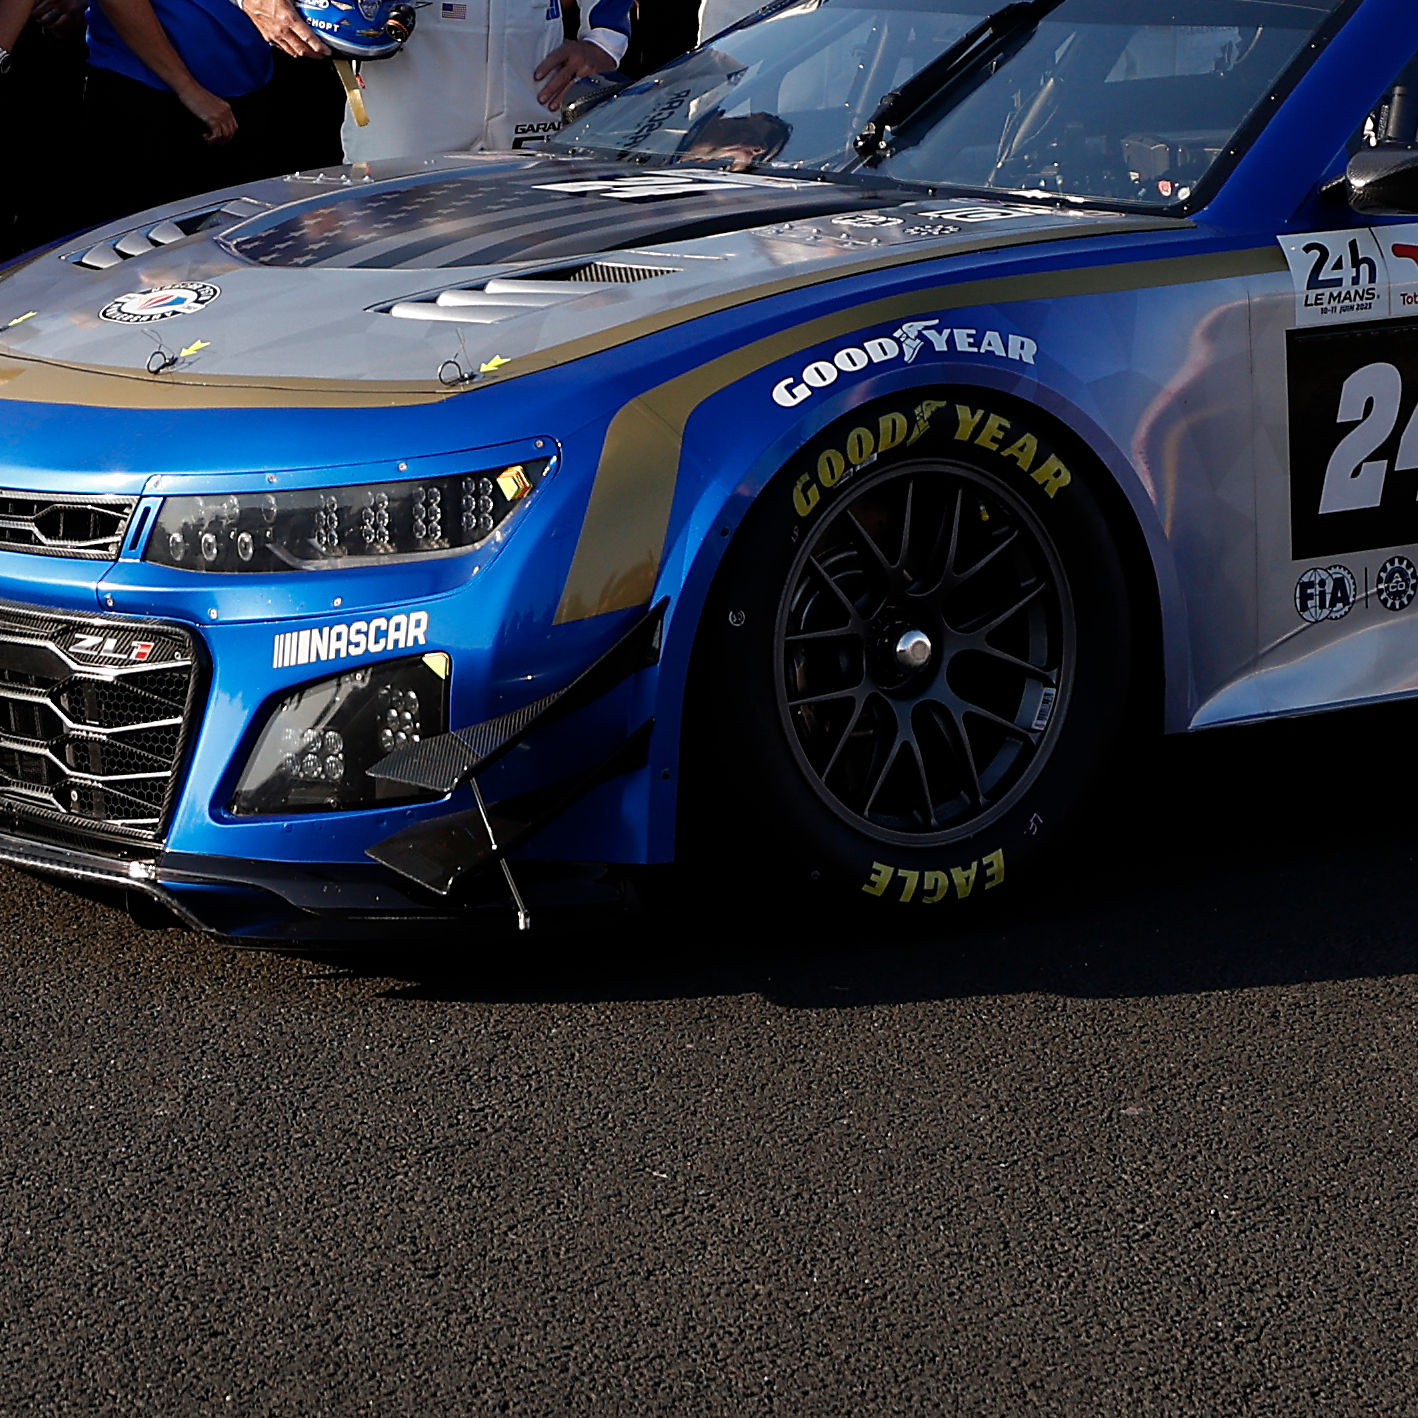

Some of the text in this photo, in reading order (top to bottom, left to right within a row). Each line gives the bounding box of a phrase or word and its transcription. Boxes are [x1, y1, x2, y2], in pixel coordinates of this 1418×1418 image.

[514, 122, 561, 135] GARA
[1302, 238, 1377, 291] 24h
[1304, 287, 1376, 308] LE MANS
[1320, 302, 1373, 316] 10-11 JUIN 2023
[68, 632, 156, 662] ZL1
[309, 610, 428, 668] NASCAR
[862, 847, 1005, 903] EAGLE
